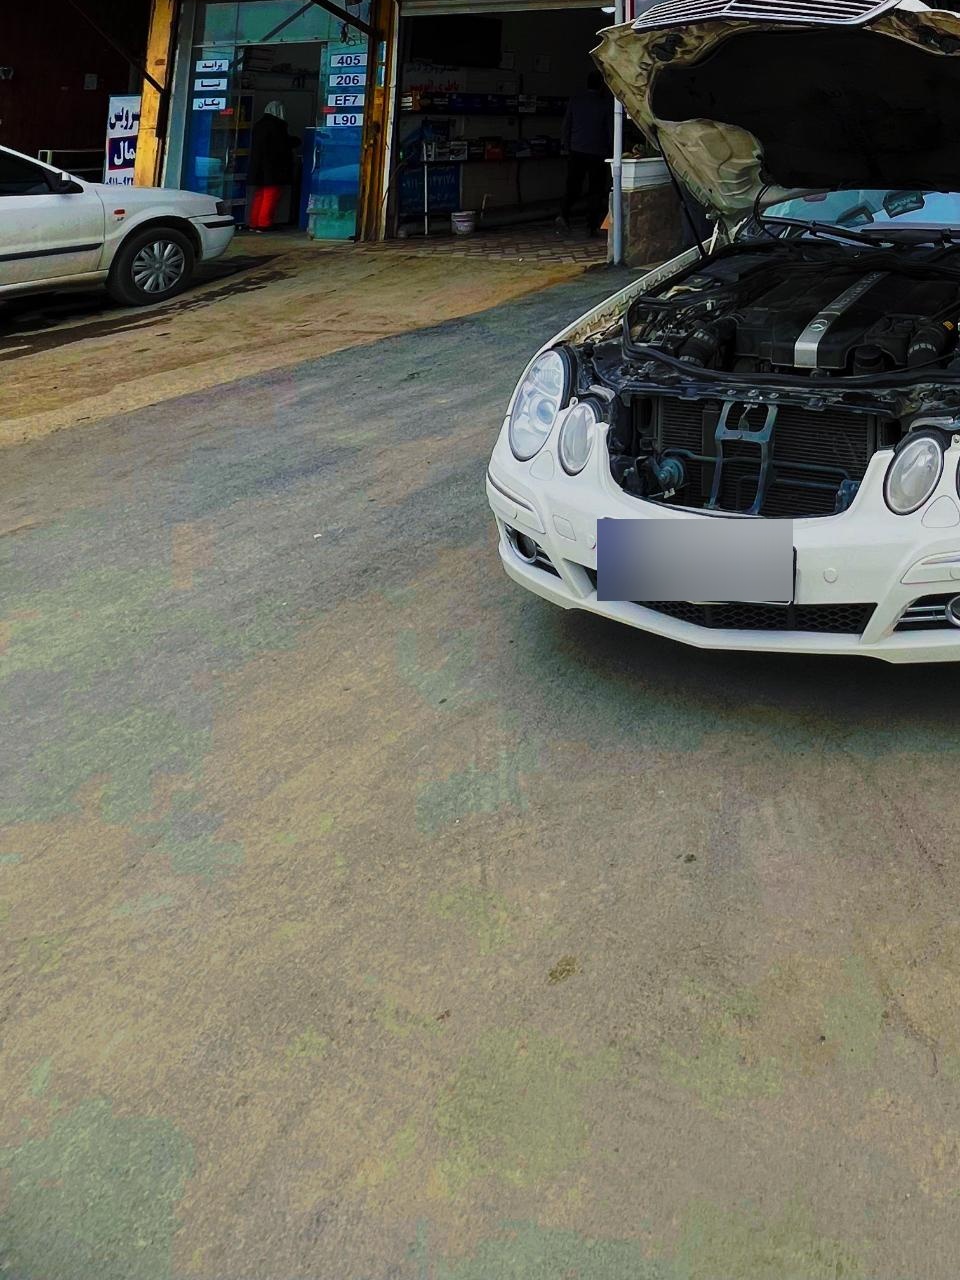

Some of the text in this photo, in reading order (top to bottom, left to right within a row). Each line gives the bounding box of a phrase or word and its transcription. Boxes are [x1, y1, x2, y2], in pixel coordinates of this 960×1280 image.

[336, 55, 361, 66] 405
[335, 75, 360, 86] 206
[334, 95, 359, 106] EF7
[333, 114, 358, 126] L90
